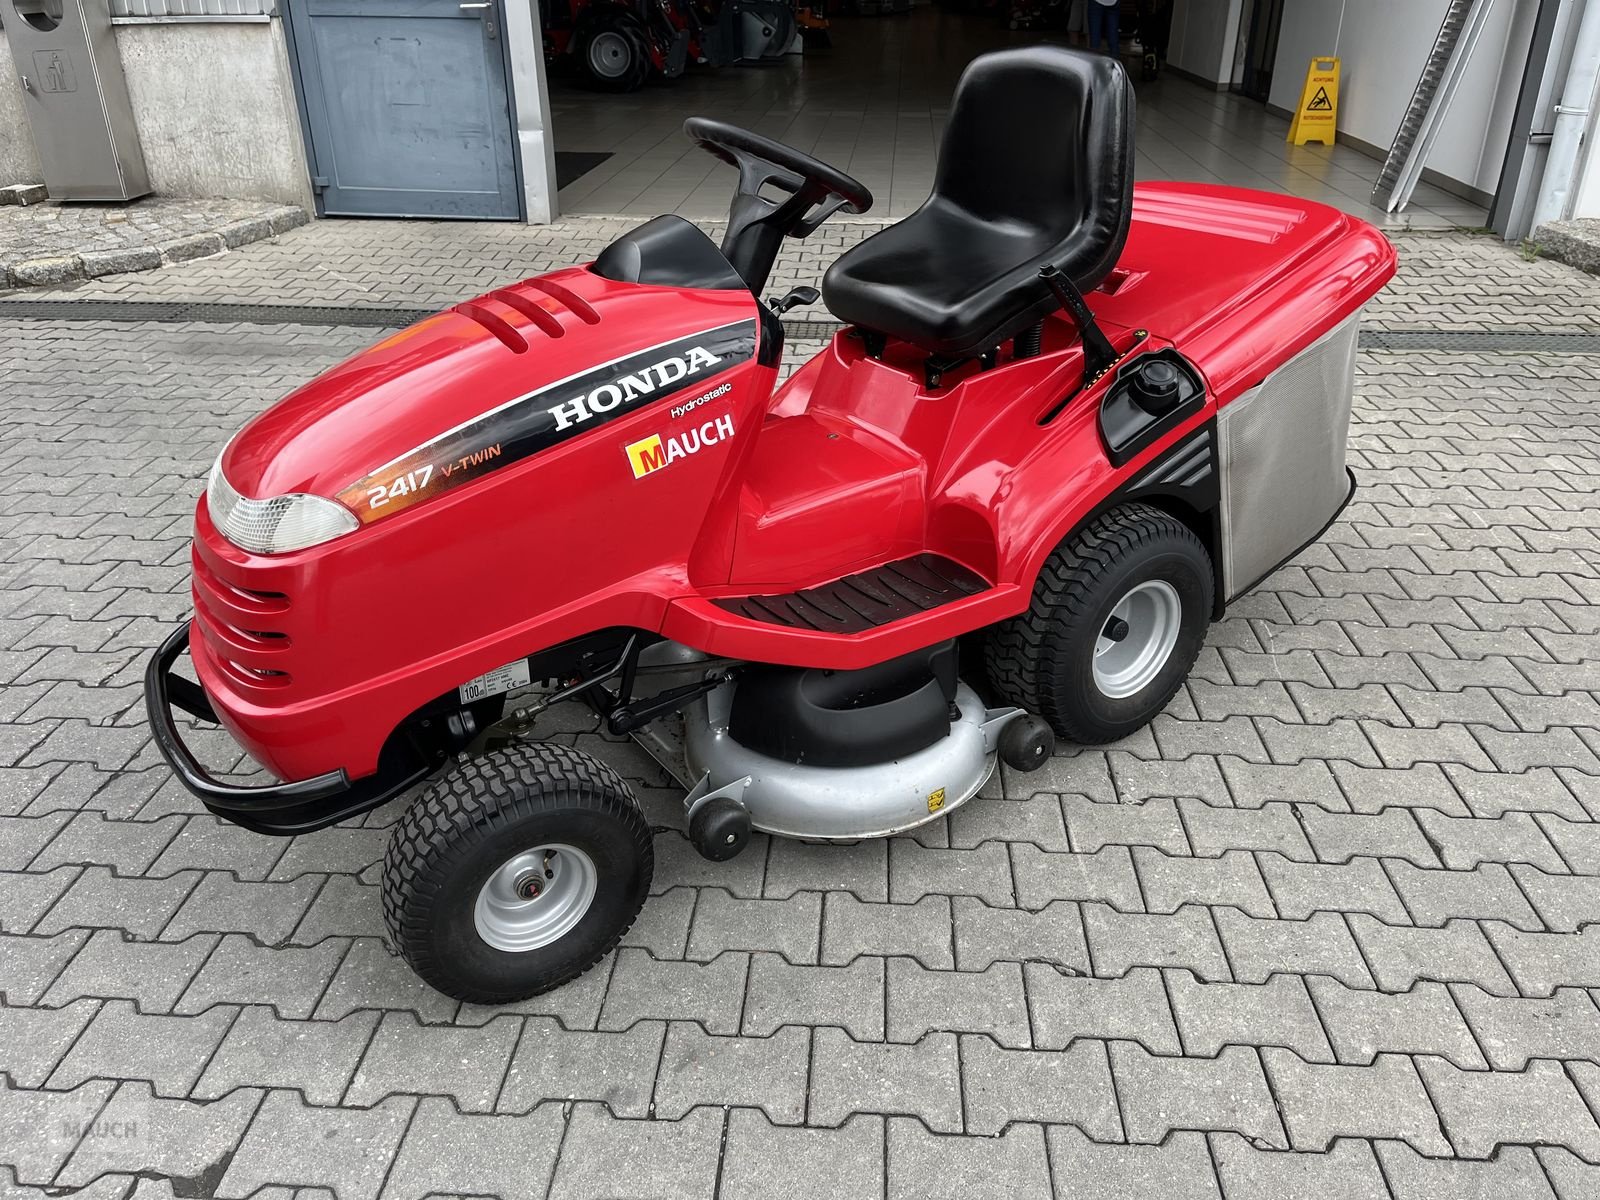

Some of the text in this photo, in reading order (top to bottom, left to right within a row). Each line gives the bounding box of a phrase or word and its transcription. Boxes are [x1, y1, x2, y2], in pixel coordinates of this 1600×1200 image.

[547, 346, 722, 432] HONDA
[670, 383, 732, 419] Hydrostatic
[367, 443, 502, 509] 2417 V-TWIN
[634, 413, 736, 477] MAUCH
[464, 684, 480, 700] 100
